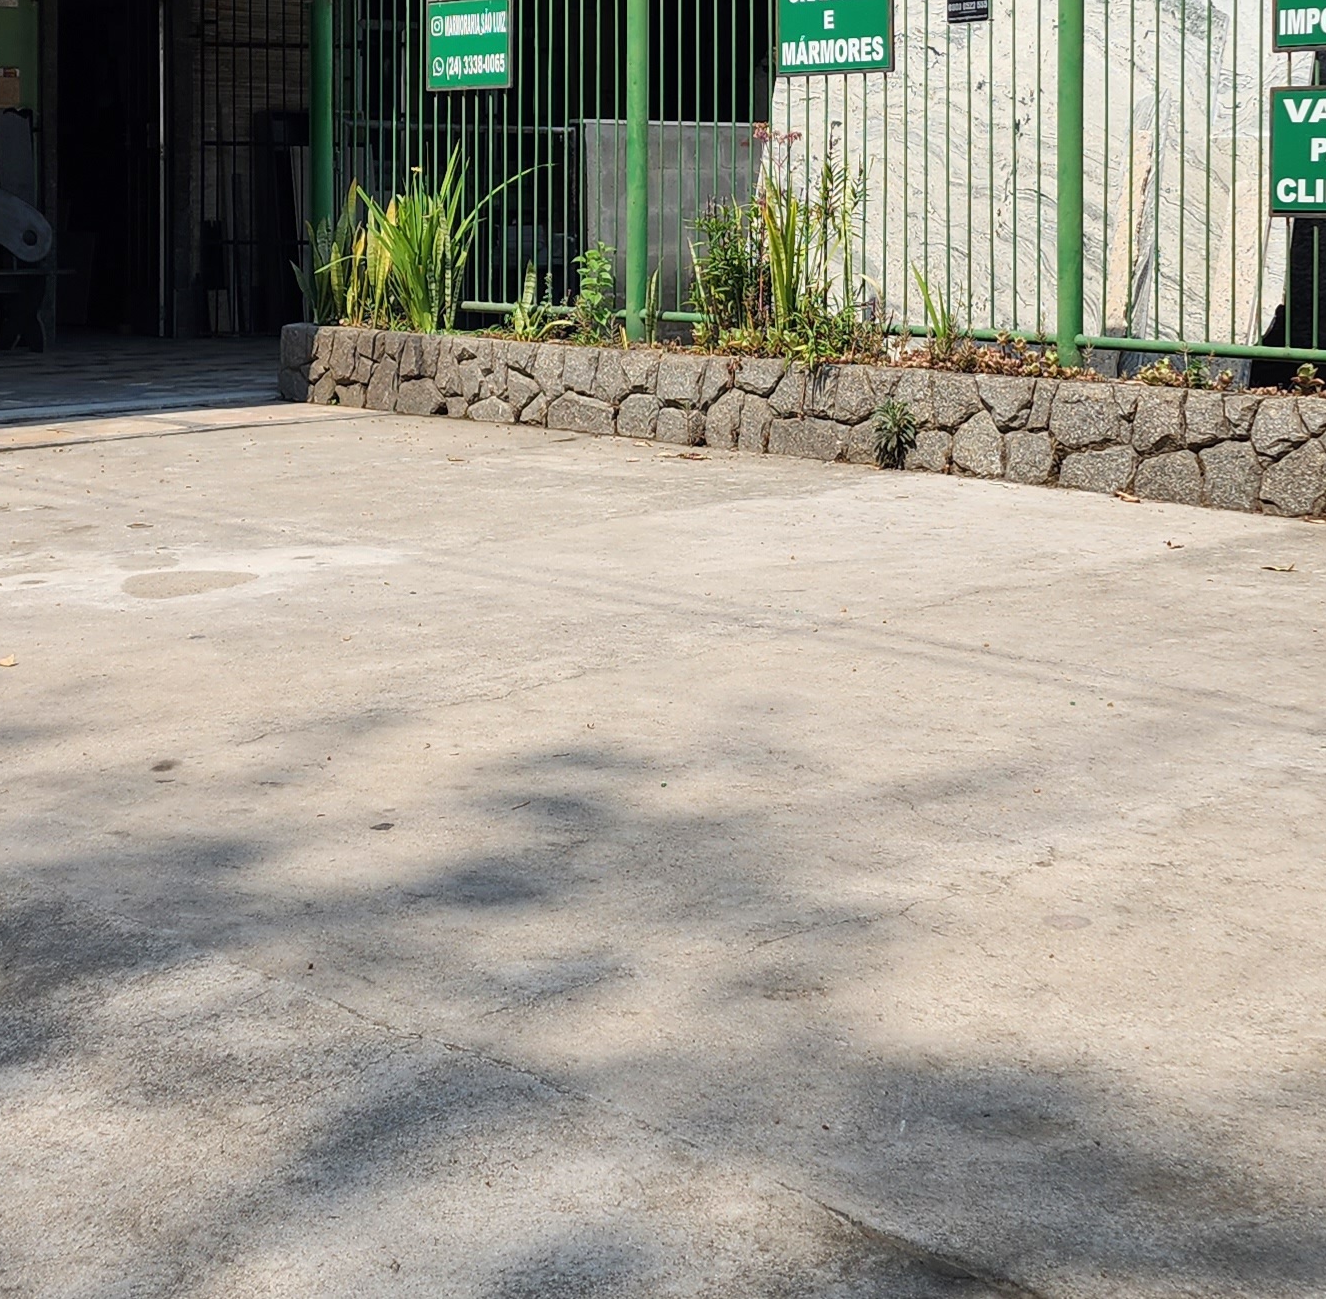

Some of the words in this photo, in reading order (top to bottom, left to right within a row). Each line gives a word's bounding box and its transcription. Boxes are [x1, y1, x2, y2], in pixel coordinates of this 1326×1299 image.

[823, 10, 834, 29] E
[782, 35, 884, 66] MÁRMORES
[446, 56, 461, 80] (24)
[463, 53, 505, 75] 3338-0065
